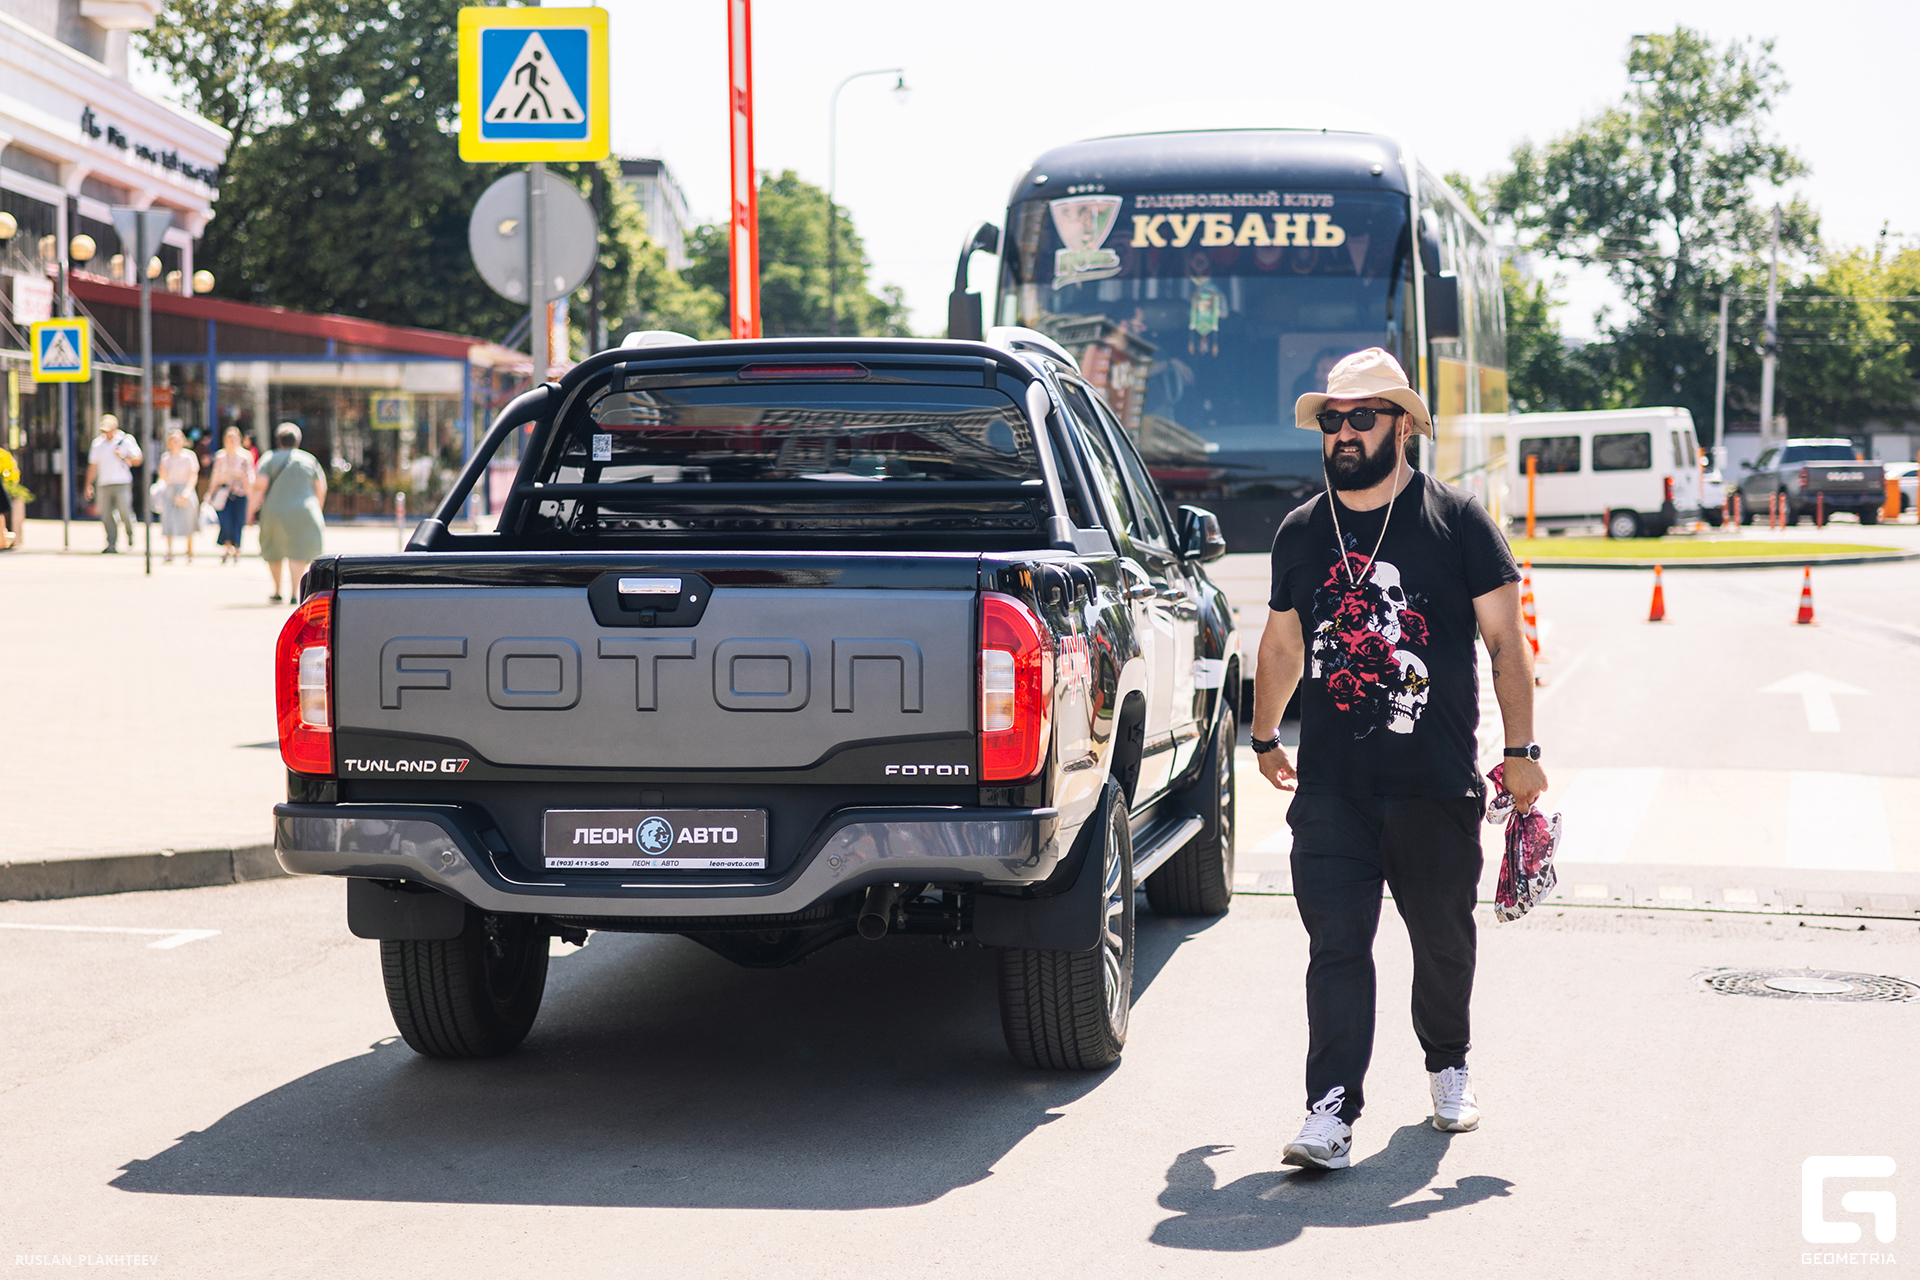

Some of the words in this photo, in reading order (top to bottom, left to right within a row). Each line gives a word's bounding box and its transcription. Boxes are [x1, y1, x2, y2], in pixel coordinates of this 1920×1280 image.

[1134, 191, 1280, 209] ГАНДБОЛЬНЫЙ
[1282, 193, 1334, 208] КЛУБ
[1130, 213, 1346, 248] КУБАНЬ
[379, 636, 924, 713] FOTON
[344, 759, 437, 772] TUNLAND
[440, 758, 470, 773] G7
[885, 764, 970, 776] FOTON
[573, 827, 633, 844] ЛЕОН
[677, 827, 738, 844] АВТО
[556, 859, 574, 867] (903)
